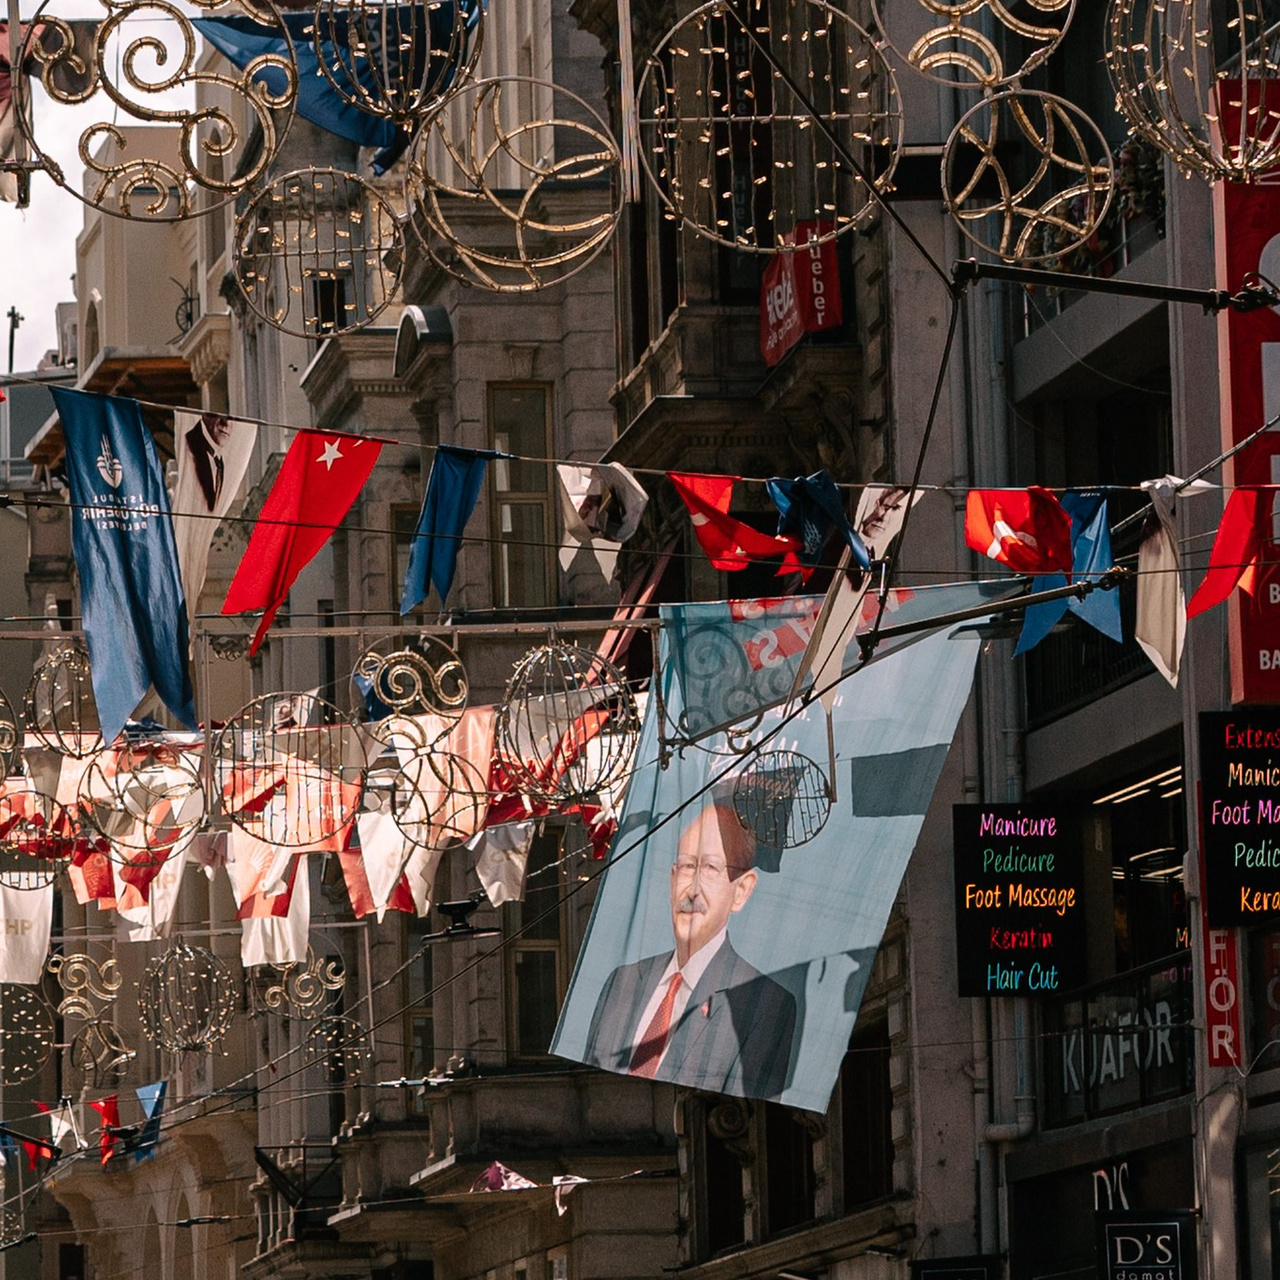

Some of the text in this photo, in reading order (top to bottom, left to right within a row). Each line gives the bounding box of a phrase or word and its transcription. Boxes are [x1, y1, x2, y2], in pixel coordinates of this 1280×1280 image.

[979, 810, 1058, 838] Manicure
[1211, 799, 1251, 826] Foot
[982, 846, 1056, 874] Pedicure
[964, 883, 1077, 917] Foot Massage
[989, 923, 1055, 950] Keratin
[986, 960, 1060, 992] Hair Cut
[1115, 1234, 1172, 1266] D'S
